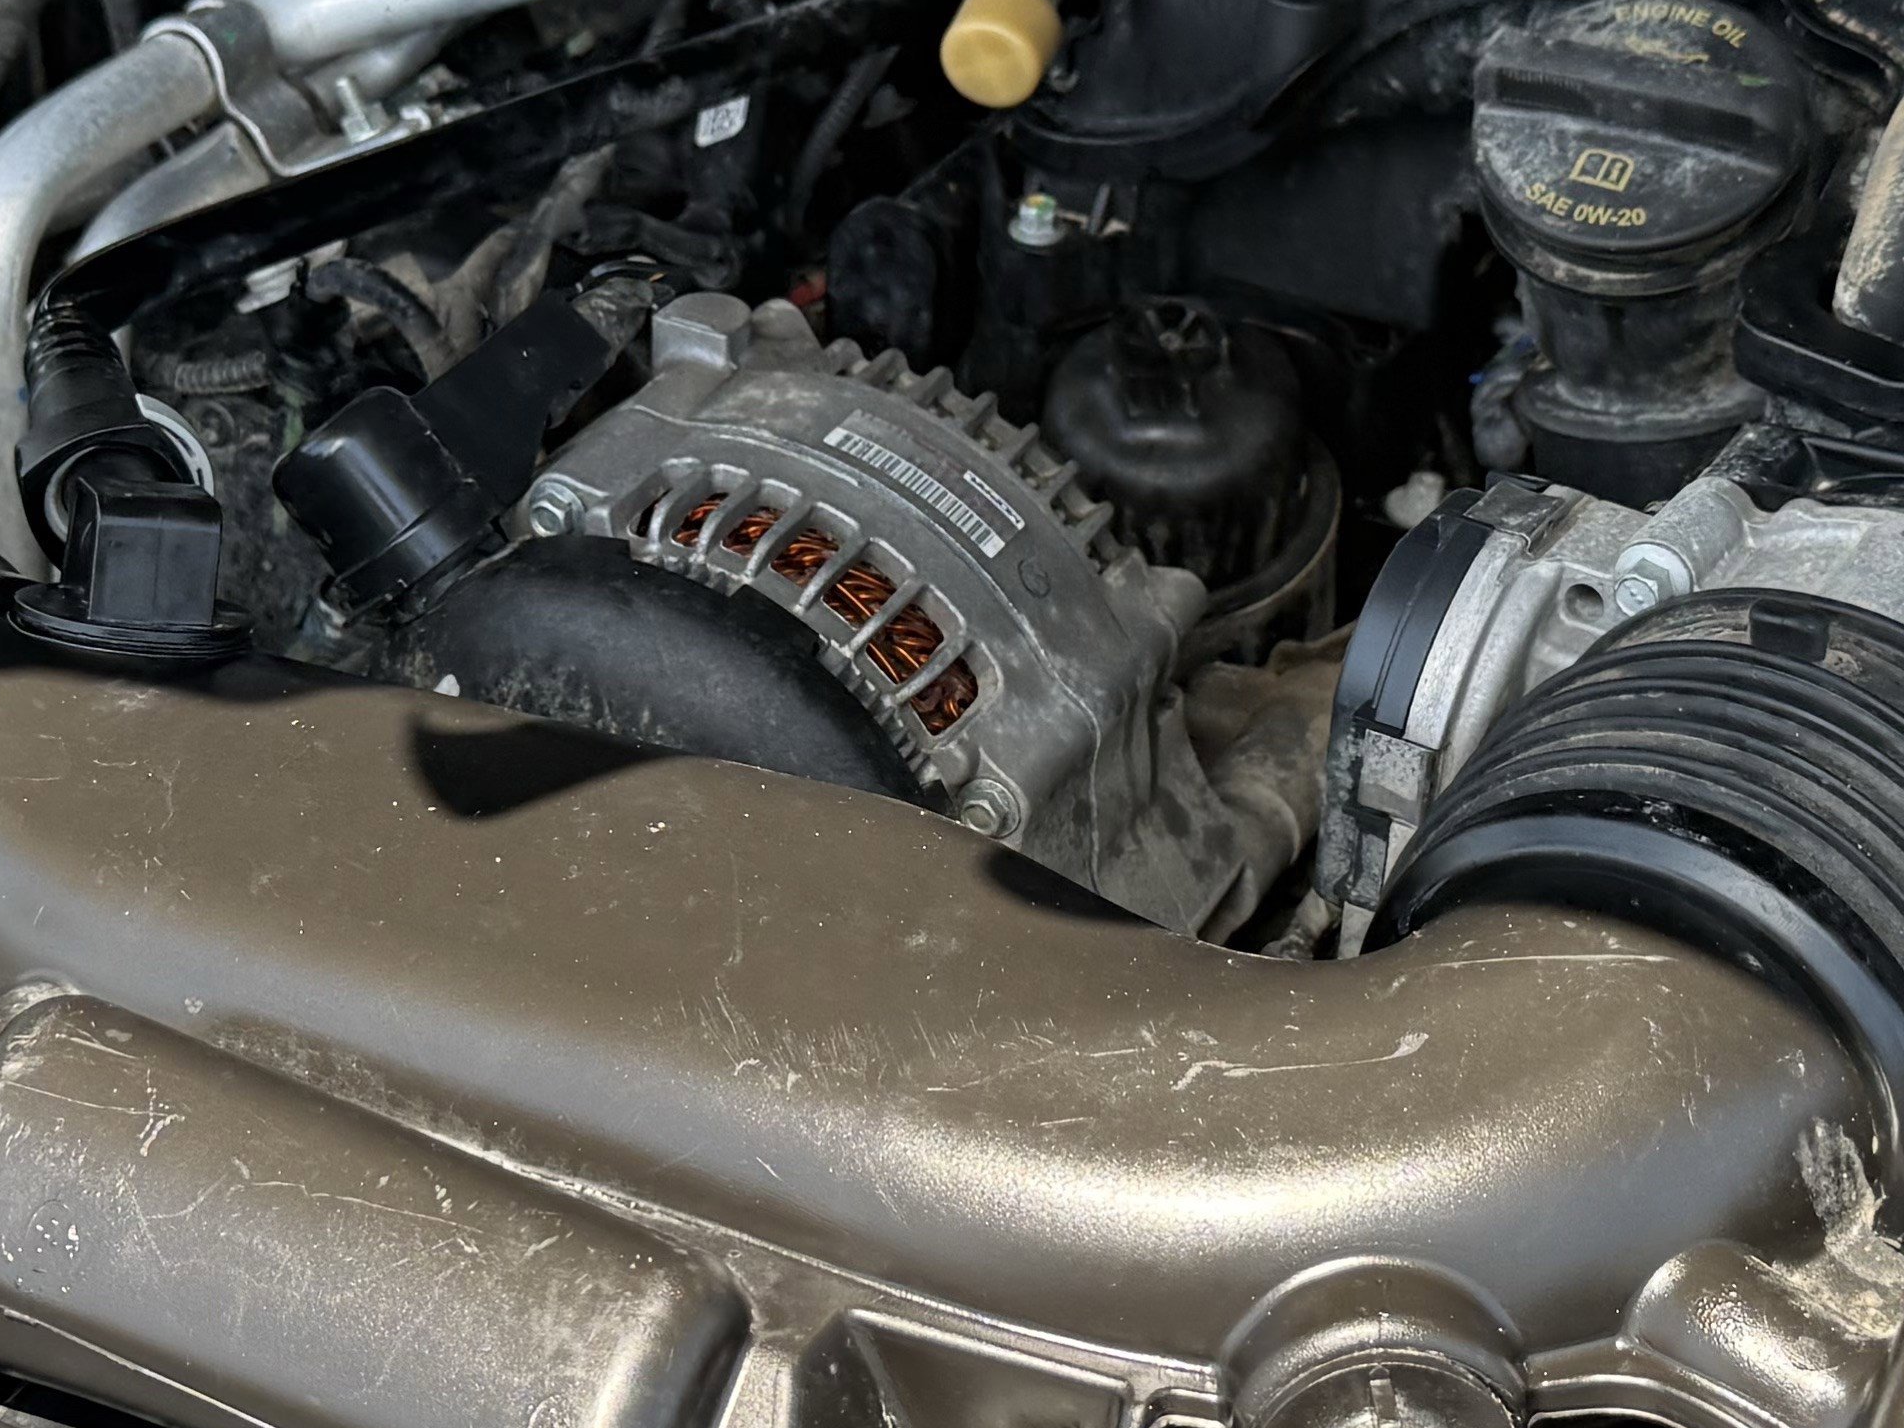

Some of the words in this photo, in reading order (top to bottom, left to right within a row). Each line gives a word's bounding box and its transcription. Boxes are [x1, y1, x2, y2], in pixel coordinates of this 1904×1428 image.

[1614, 0, 1712, 29] ENGINE
[1711, 18, 1750, 49] OIL
[1526, 183, 1574, 218] SAE
[1572, 203, 1648, 228] 0W-20
